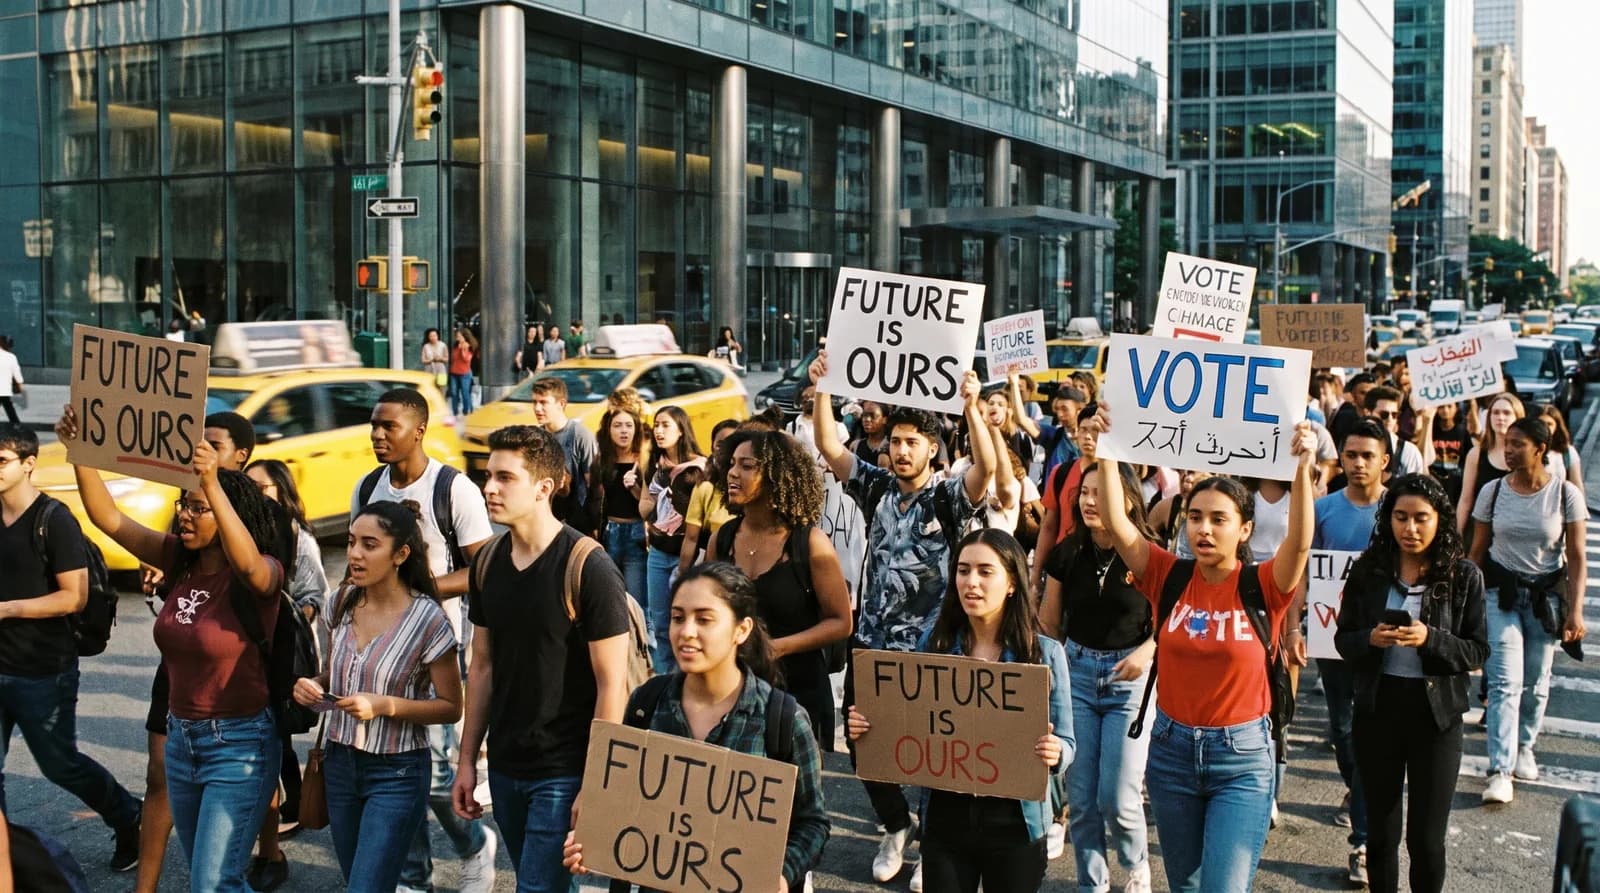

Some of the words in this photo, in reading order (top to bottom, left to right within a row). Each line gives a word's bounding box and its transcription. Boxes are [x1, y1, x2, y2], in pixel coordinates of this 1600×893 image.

[841, 277, 968, 324] FUTURE
[1179, 261, 1244, 295] VOTE
[877, 321, 903, 346] IS
[991, 330, 1035, 352] FUTURE
[81, 335, 197, 399] FUTURE
[847, 347, 959, 401] OURS
[1128, 347, 1285, 424] VOTE
[82, 397, 106, 447] IS
[116, 404, 194, 465] OURS
[874, 660, 1025, 712] FUTURE
[929, 709, 956, 736] IS
[603, 738, 783, 825] FUTURE
[895, 736, 999, 785] OURS
[669, 811, 693, 837] IS
[613, 826, 743, 893] OURS
